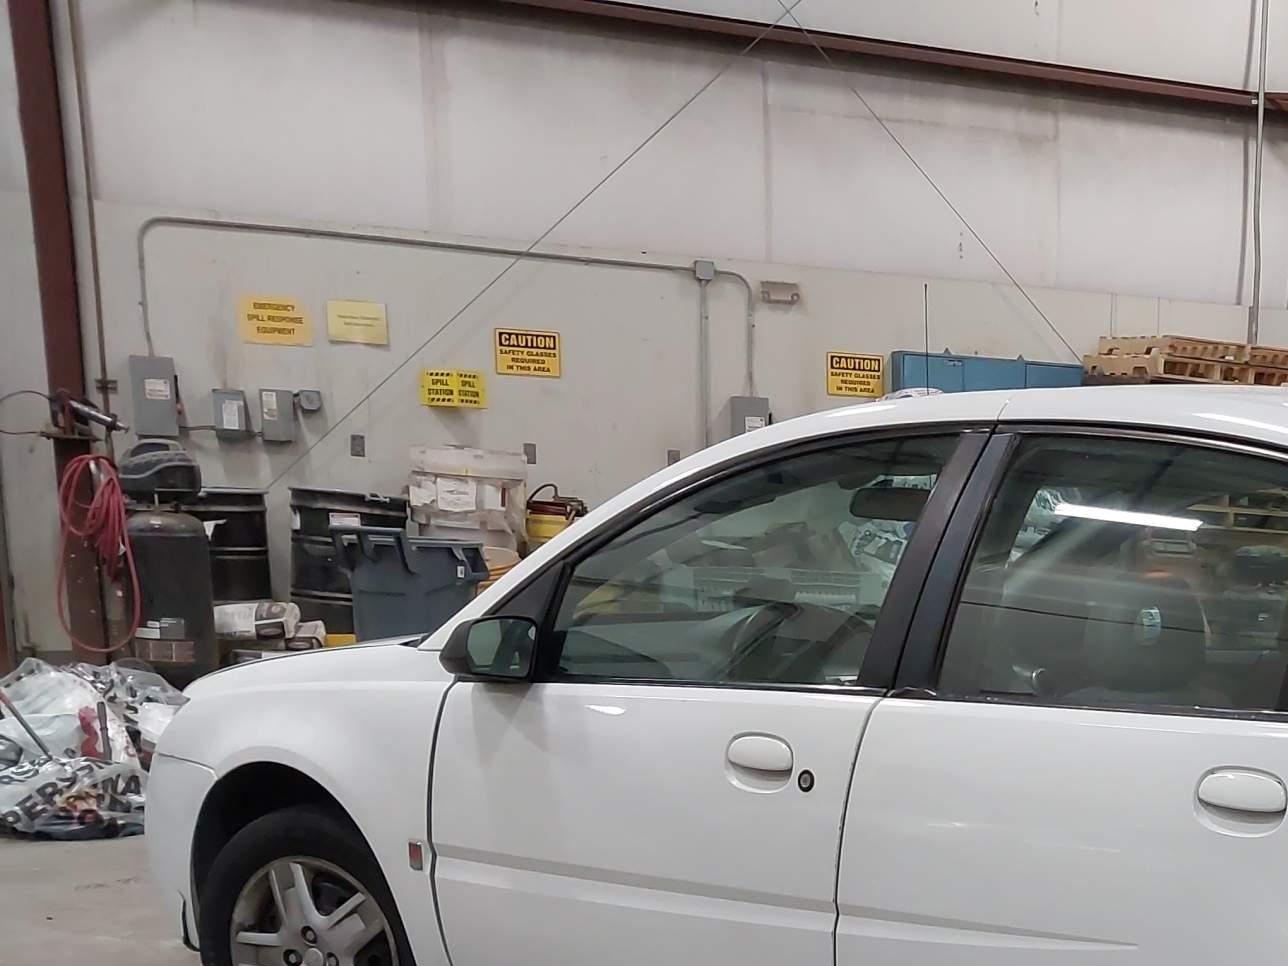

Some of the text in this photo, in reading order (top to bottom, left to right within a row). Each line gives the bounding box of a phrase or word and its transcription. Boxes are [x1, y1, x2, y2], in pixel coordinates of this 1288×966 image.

[247, 313, 304, 324] SPILL RESPONSE
[256, 326, 296, 336] EQUIPMENT
[501, 334, 554, 349] CAUTION
[499, 349, 557, 358] SAFETY GLASSES
[511, 357, 546, 365] REQUIRED
[833, 357, 878, 371] CAUTION
[431, 378, 449, 387] SPILL
[460, 380, 476, 388] SPILL
[841, 379, 870, 387] REQUIRED
[428, 388, 453, 396] STATION
[458, 389, 480, 398] STATION
